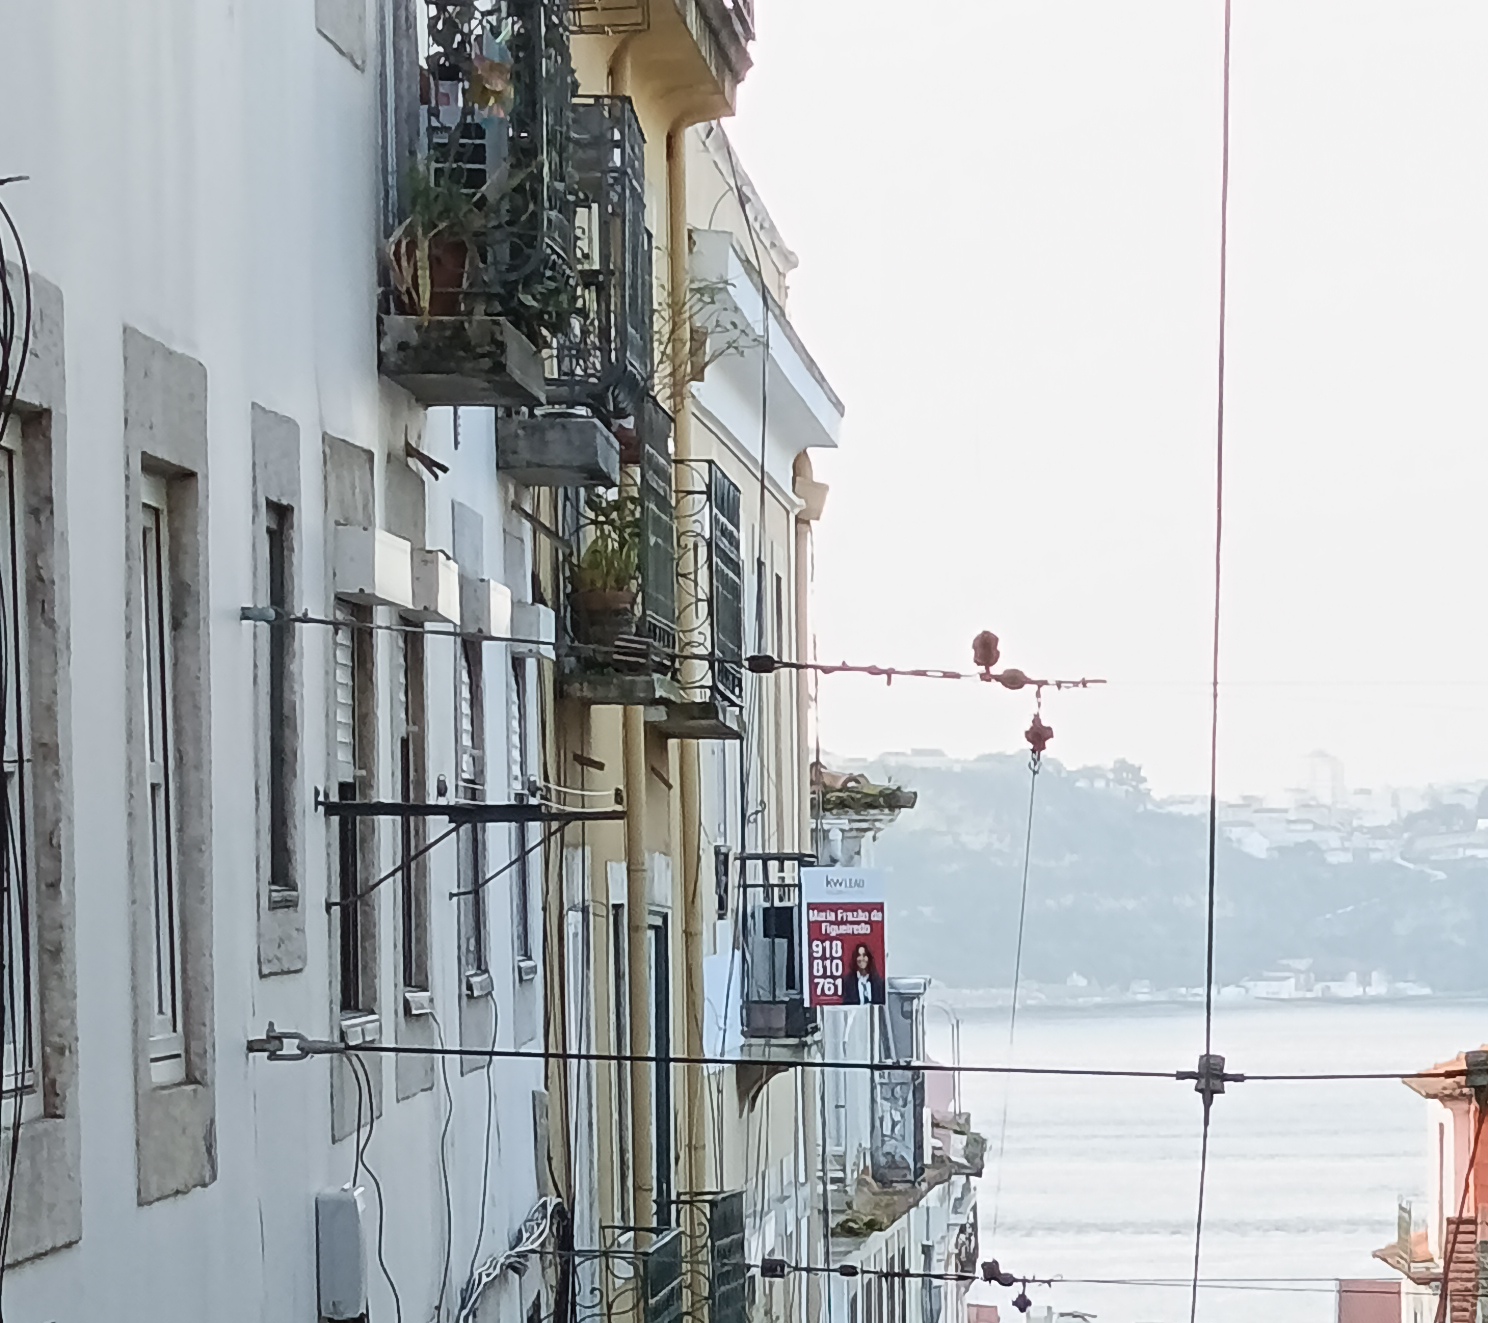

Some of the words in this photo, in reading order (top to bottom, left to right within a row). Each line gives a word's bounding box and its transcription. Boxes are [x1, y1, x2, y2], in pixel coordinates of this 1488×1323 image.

[822, 922, 871, 936] Figueiredo
[812, 940, 842, 958] 918
[813, 959, 843, 976] 810
[814, 978, 843, 996] 761
